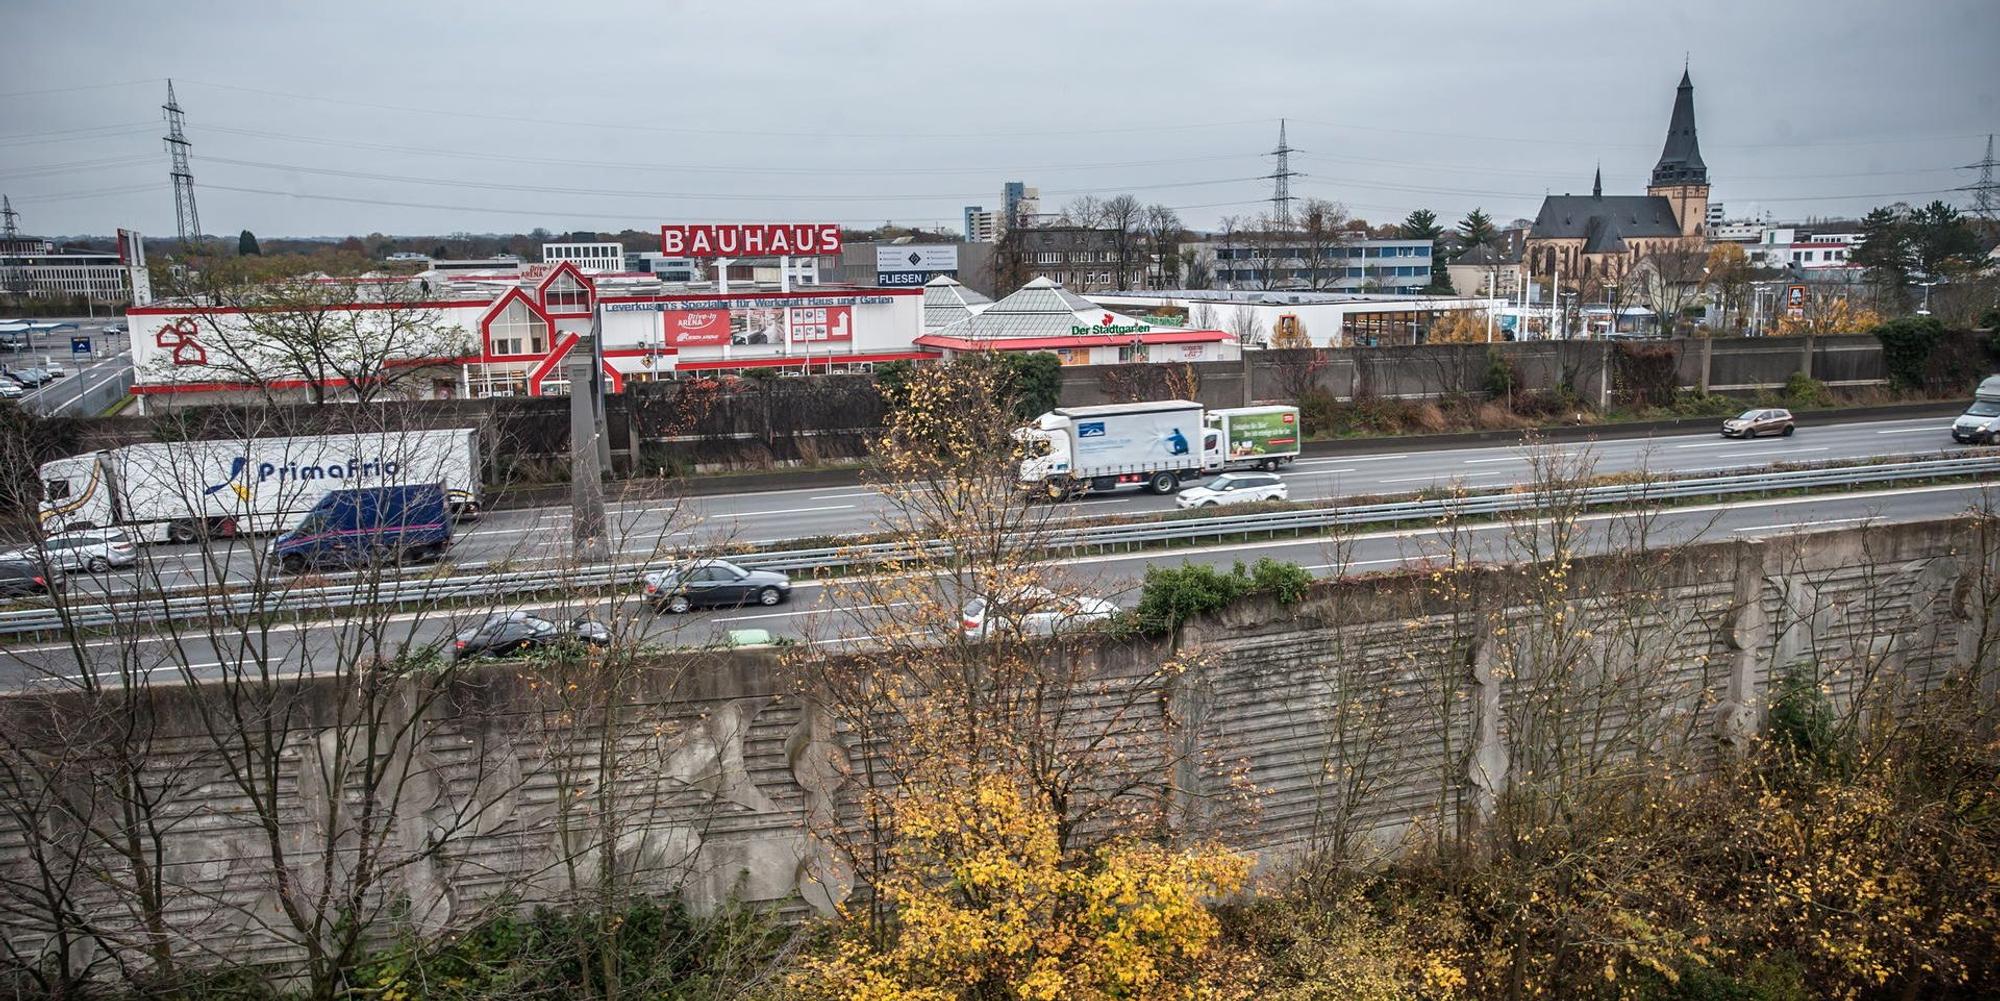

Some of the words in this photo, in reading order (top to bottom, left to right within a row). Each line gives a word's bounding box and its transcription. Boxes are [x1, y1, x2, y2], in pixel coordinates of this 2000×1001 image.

[665, 229, 839, 253] BAUHAUS
[879, 274, 922, 284] FLIESEN
[605, 300, 677, 312] Leverkusn's
[681, 298, 733, 311] Spezialit
[736, 298, 751, 309] für
[755, 297, 804, 308] Werkstatt
[808, 296, 834, 306] Haus
[838, 295, 856, 306] und
[860, 295, 894, 304] Garten
[677, 318, 704, 327] ARENA
[1071, 325, 1090, 335] Der
